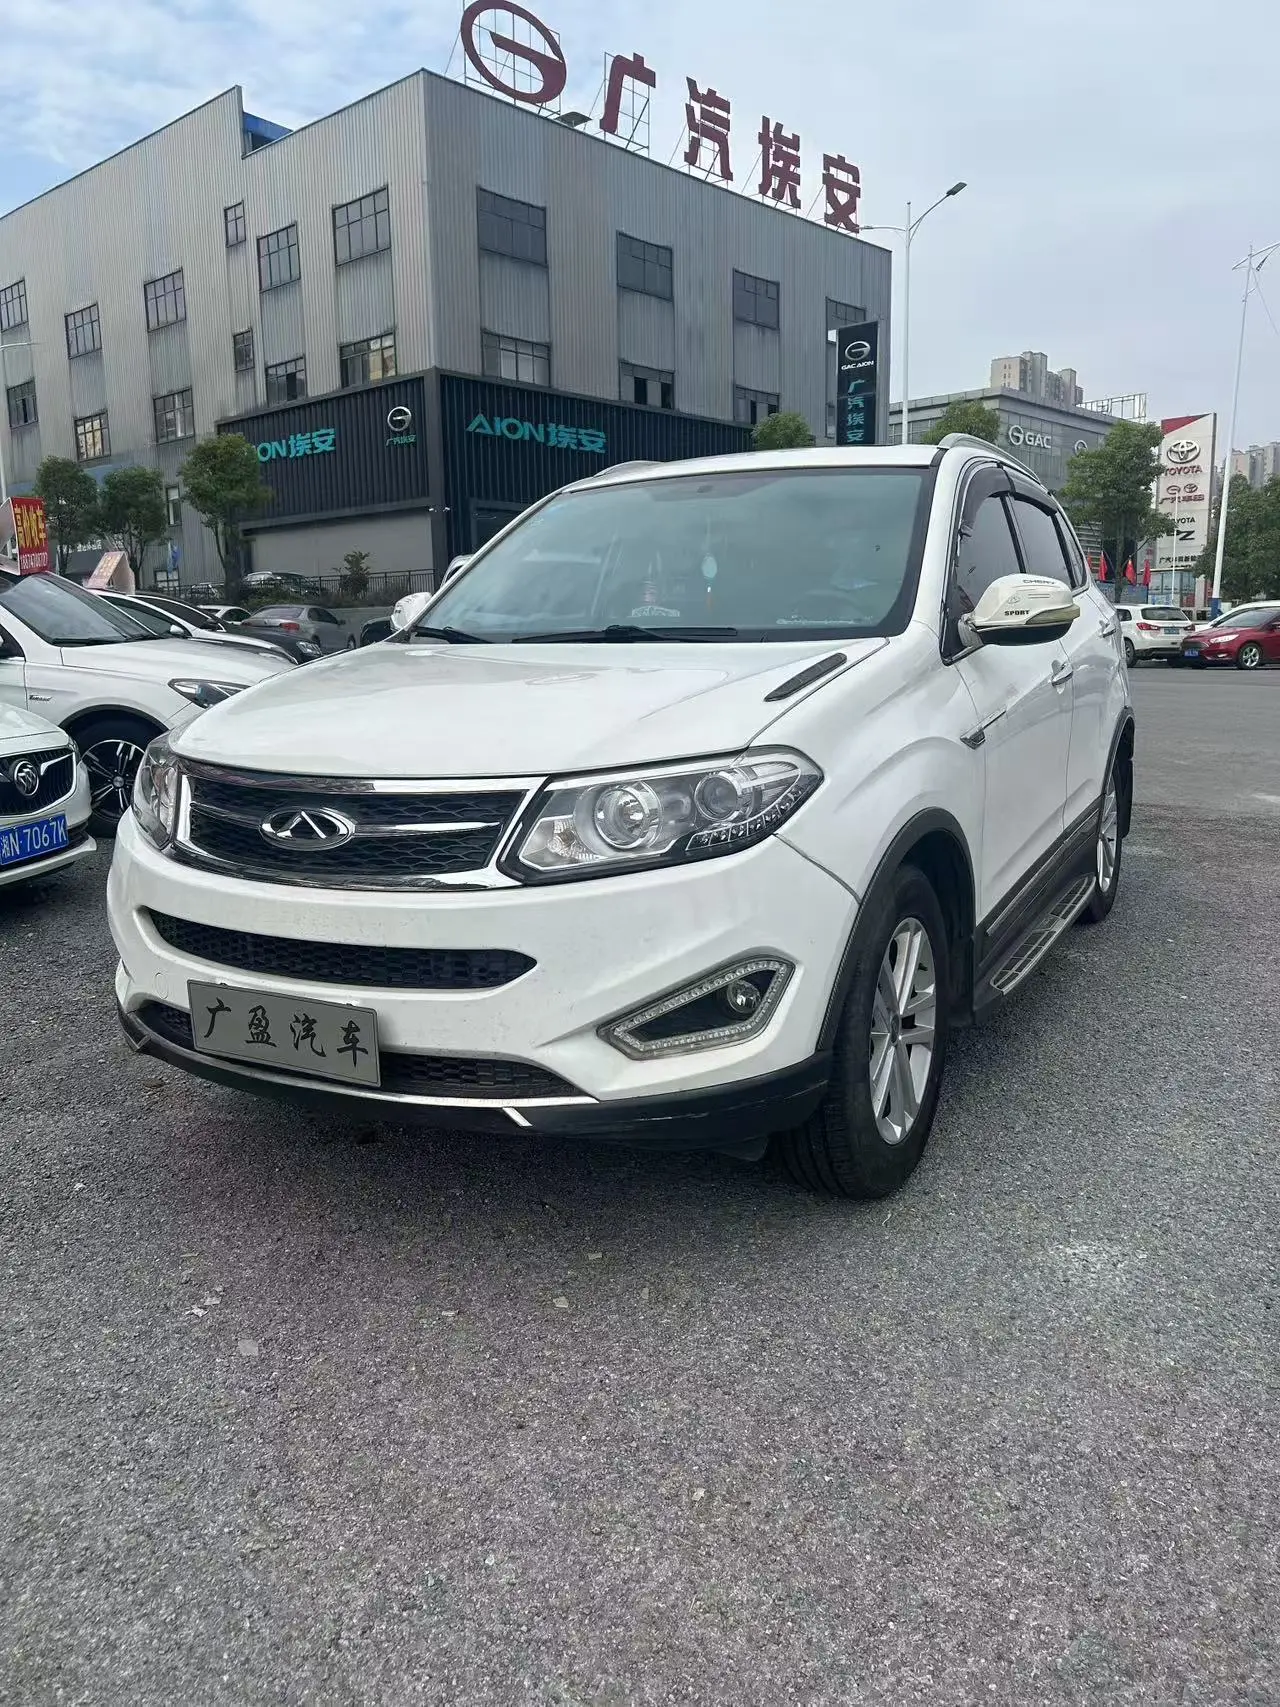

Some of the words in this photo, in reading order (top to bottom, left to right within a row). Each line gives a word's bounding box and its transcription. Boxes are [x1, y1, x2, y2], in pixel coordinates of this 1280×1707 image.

[599, 52, 861, 233] 广汽埃安
[846, 379, 865, 443] 广汽埃安
[1025, 432, 1052, 449] GAC
[1164, 465, 1203, 477] TOYOTA
[1004, 609, 1031, 617] SPORT
[204, 997, 369, 1068] 广盈汽车
